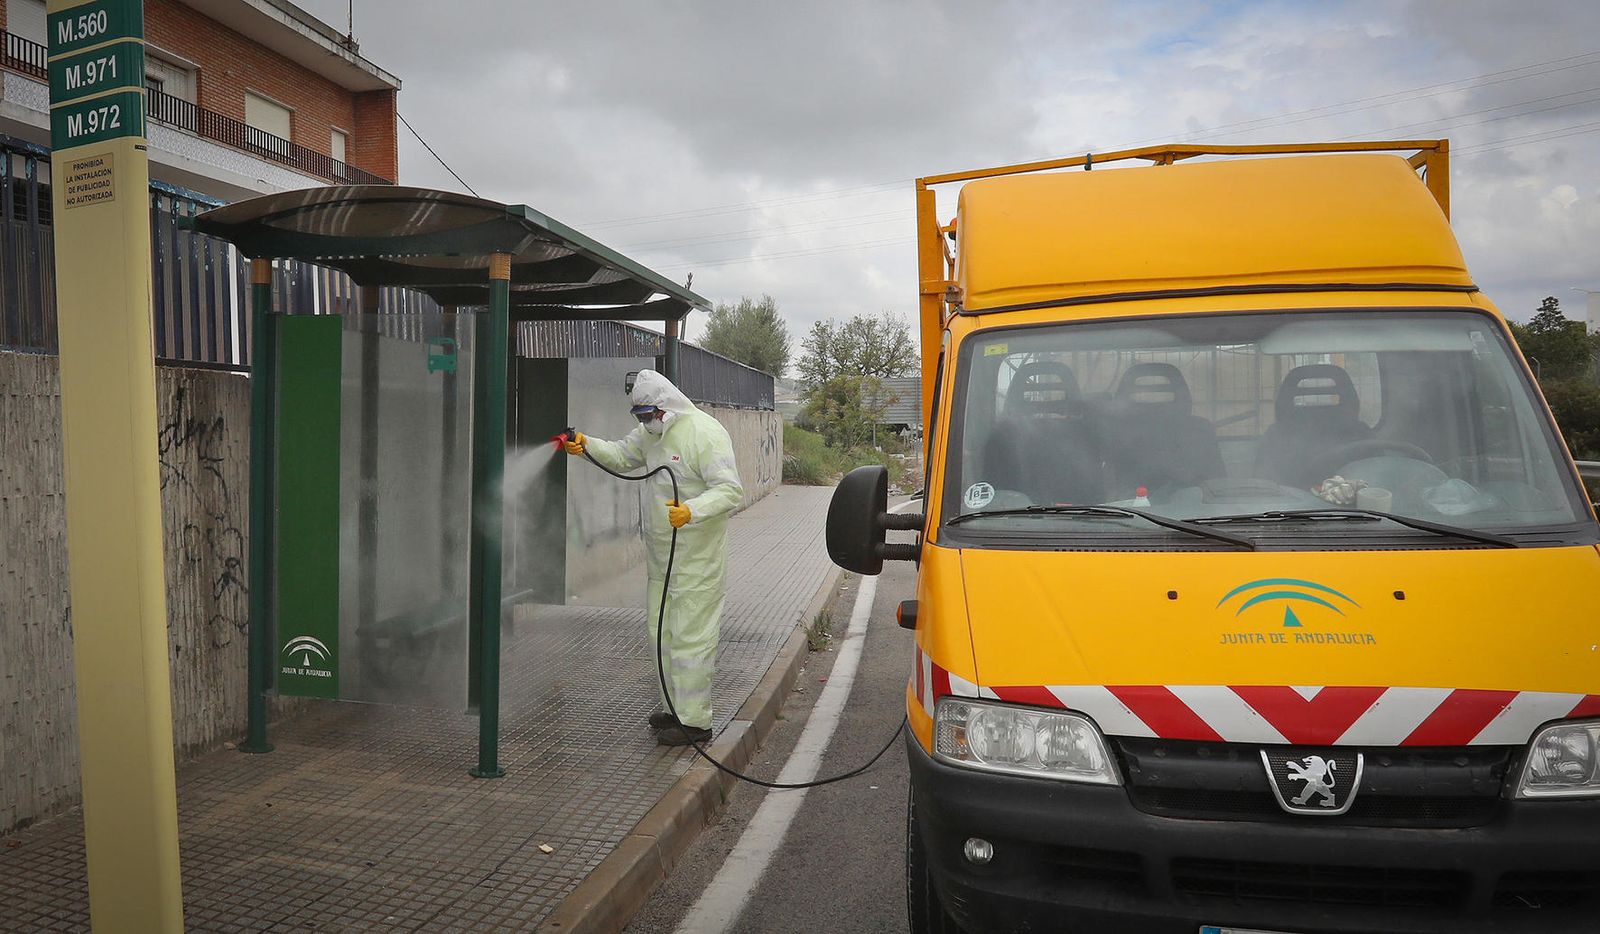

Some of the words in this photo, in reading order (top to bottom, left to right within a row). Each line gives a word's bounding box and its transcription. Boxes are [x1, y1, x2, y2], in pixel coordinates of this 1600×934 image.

[58, 9, 107, 44] M.560
[65, 54, 117, 90] M.971
[67, 104, 121, 138] M.972
[73, 159, 103, 170] PROHIBIDA
[76, 180, 110, 191] PUBLICIDAD
[66, 198, 76, 206] NO
[76, 191, 112, 203] AUTORIZADA
[1220, 633, 1266, 645] JUNTA
[1270, 632, 1288, 644] DE
[1295, 632, 1377, 645] ANDALUCIA
